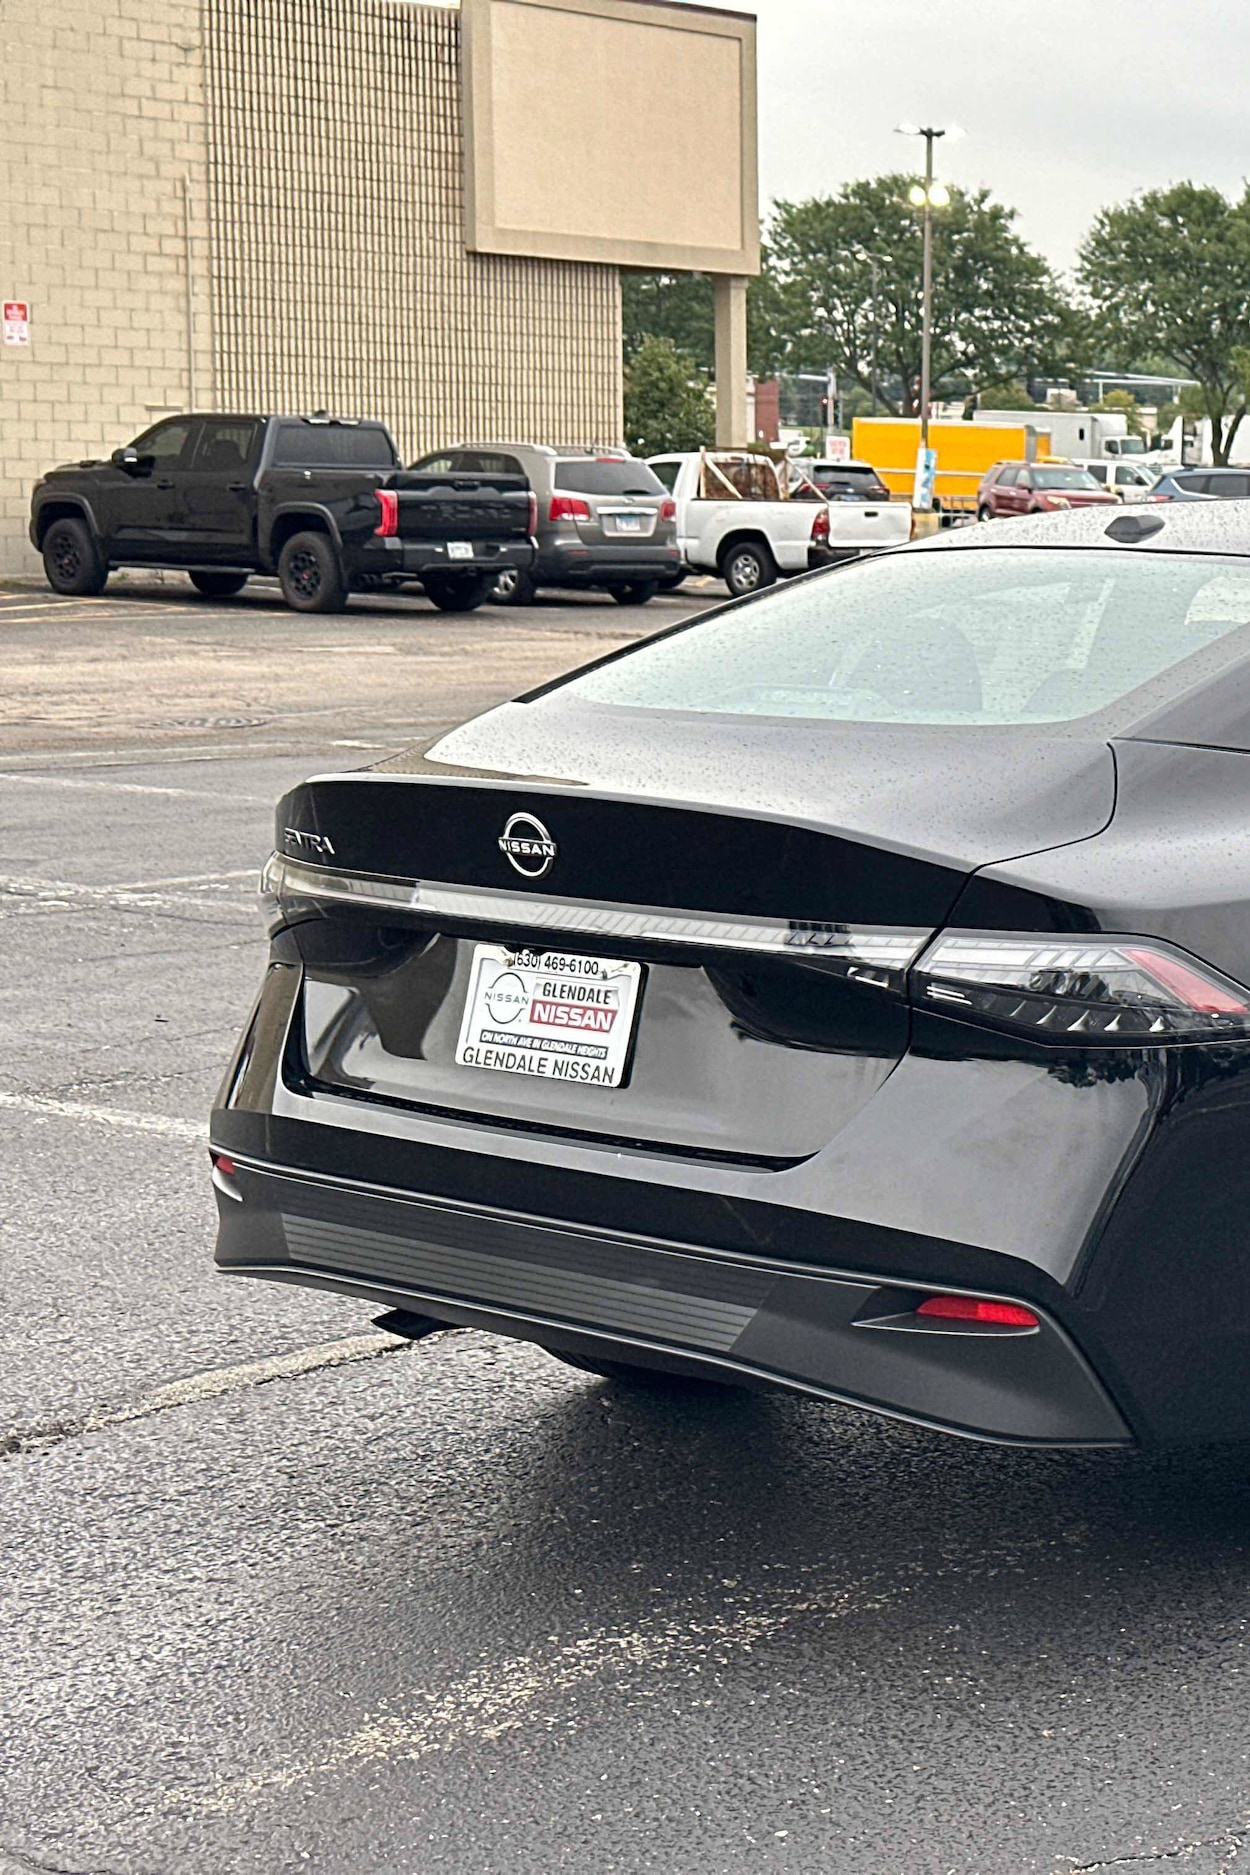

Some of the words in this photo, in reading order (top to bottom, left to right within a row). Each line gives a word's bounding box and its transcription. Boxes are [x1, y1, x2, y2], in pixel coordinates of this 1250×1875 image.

[499, 837, 555, 857] NISSAN
[513, 952, 541, 969] (630)
[544, 956, 599, 975] 469-6100
[484, 991, 529, 1005] NISSAN
[542, 982, 612, 1004] GLENDALE
[533, 1003, 613, 1030] NISSAN
[482, 1032, 493, 1041] ON
[494, 1032, 517, 1045] NORTH
[518, 1036, 532, 1047] AVE
[532, 1038, 541, 1048] IN
[541, 1040, 577, 1053] GLENDALE
[577, 1045, 607, 1057] HEIGHTS
[463, 1046, 549, 1074] GLENDALE
[552, 1059, 615, 1084] NISSAN
